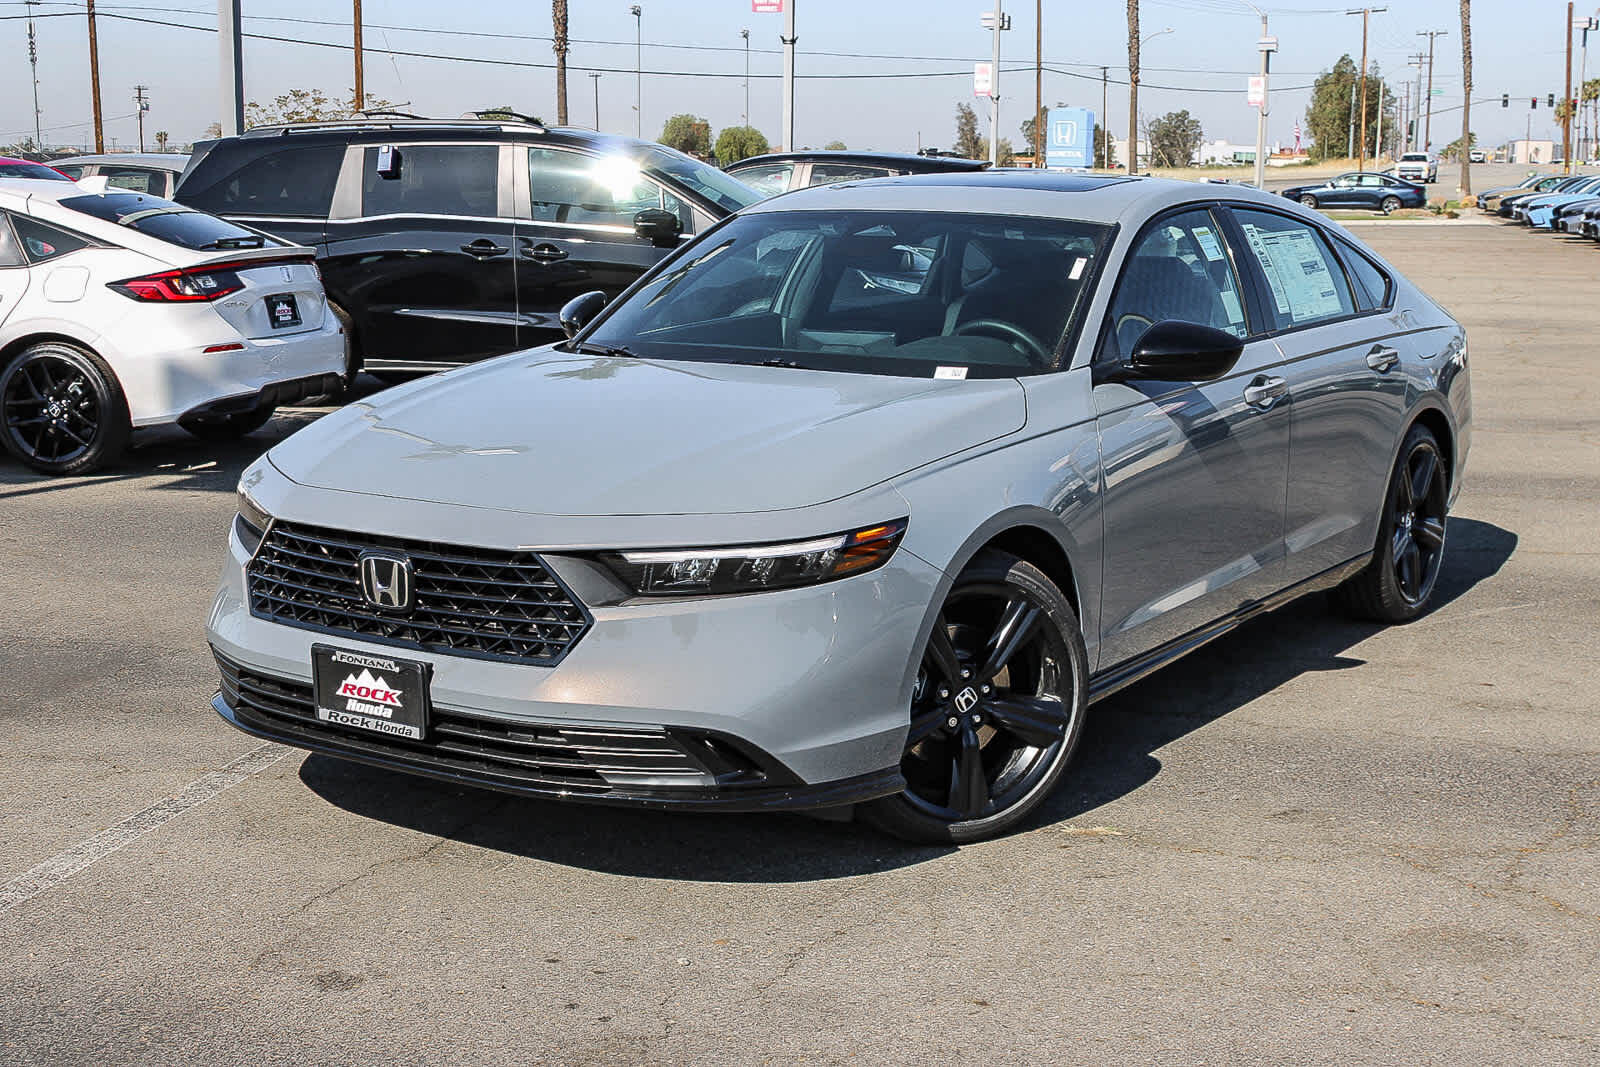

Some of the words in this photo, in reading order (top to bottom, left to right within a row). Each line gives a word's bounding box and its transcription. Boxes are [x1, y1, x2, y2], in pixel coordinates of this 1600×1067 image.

[340, 655, 394, 670] FONTANA
[342, 683, 398, 703] ROCK
[346, 699, 393, 718] Honda
[328, 711, 371, 728] Rock
[374, 721, 413, 737] Honda
